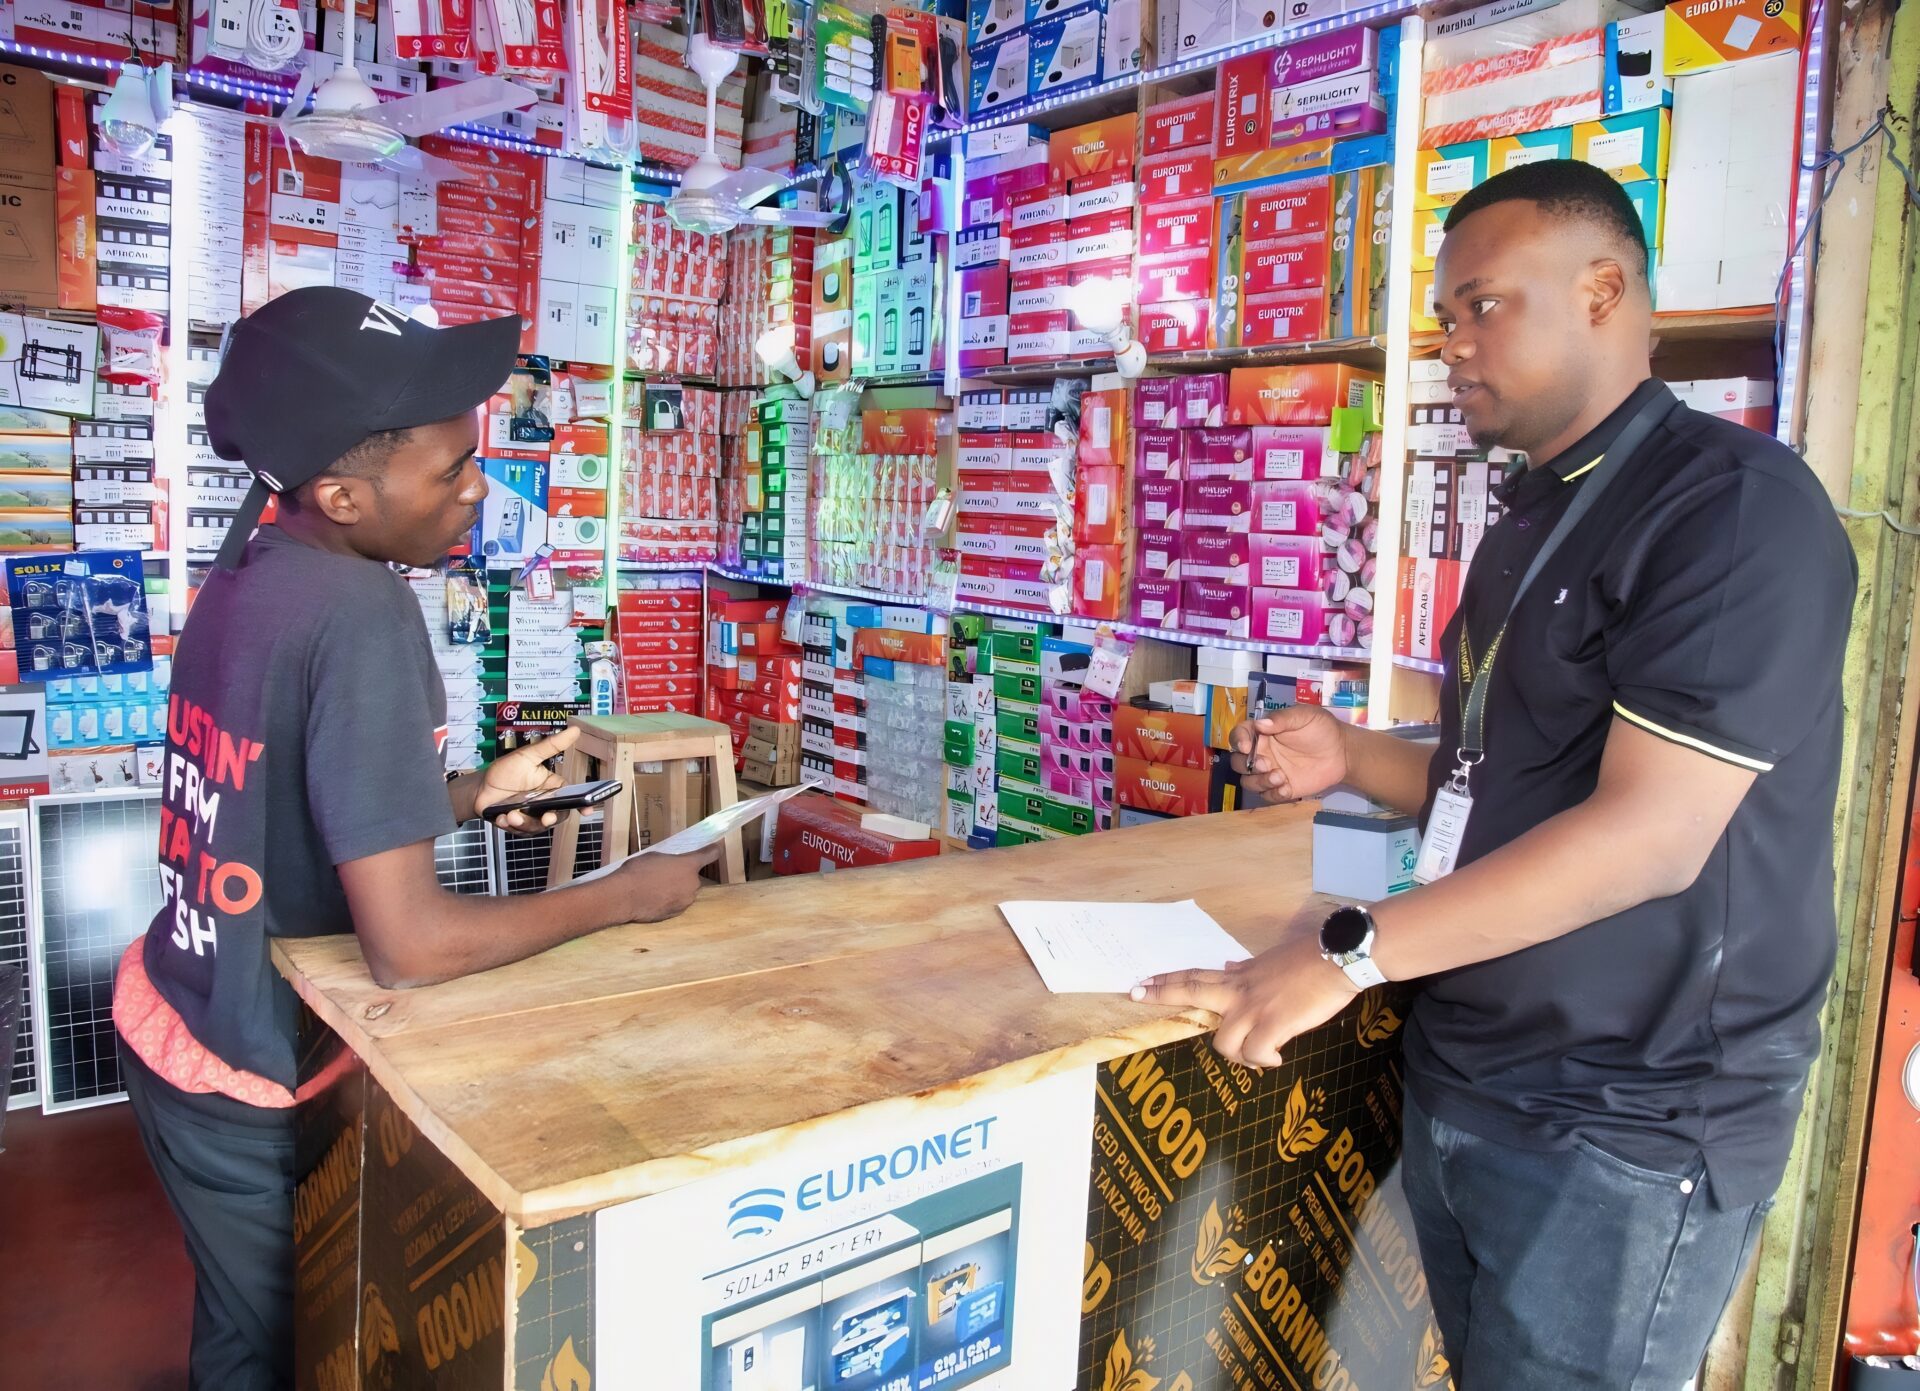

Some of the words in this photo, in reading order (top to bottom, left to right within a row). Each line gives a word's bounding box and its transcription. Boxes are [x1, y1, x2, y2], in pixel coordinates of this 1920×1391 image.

[1767, 2, 1783, 13] 30
[1296, 44, 1358, 70] SEPHLIGHTY
[1297, 85, 1360, 107] SEPHLIGHTY
[1156, 112, 1196, 128] EUROTRIX
[1226, 75, 1239, 148] EUROTRIX
[1152, 162, 1193, 179] EUROTRIX
[1260, 196, 1307, 213] EUROTRIX
[1157, 214, 1198, 229] EUROTRIX
[1257, 251, 1303, 266] EUROTRIX
[1258, 306, 1304, 320] EUROTRIX
[1419, 593, 1429, 646] AFRICAB
[522, 710, 542, 720] KAI
[1136, 728, 1173, 741] TRONIC
[1140, 778, 1176, 792] TRONIC
[802, 830, 855, 865] EUROTRIX
[797, 1116, 998, 1212] EURONET
[1114, 1151, 1162, 1221] PLYWOOD
[1094, 1166, 1147, 1246] TANZANIA
[723, 1263, 789, 1300] SOLAR
[1219, 1306, 1257, 1362] PREMIUM
[1205, 1327, 1236, 1369] MADE
